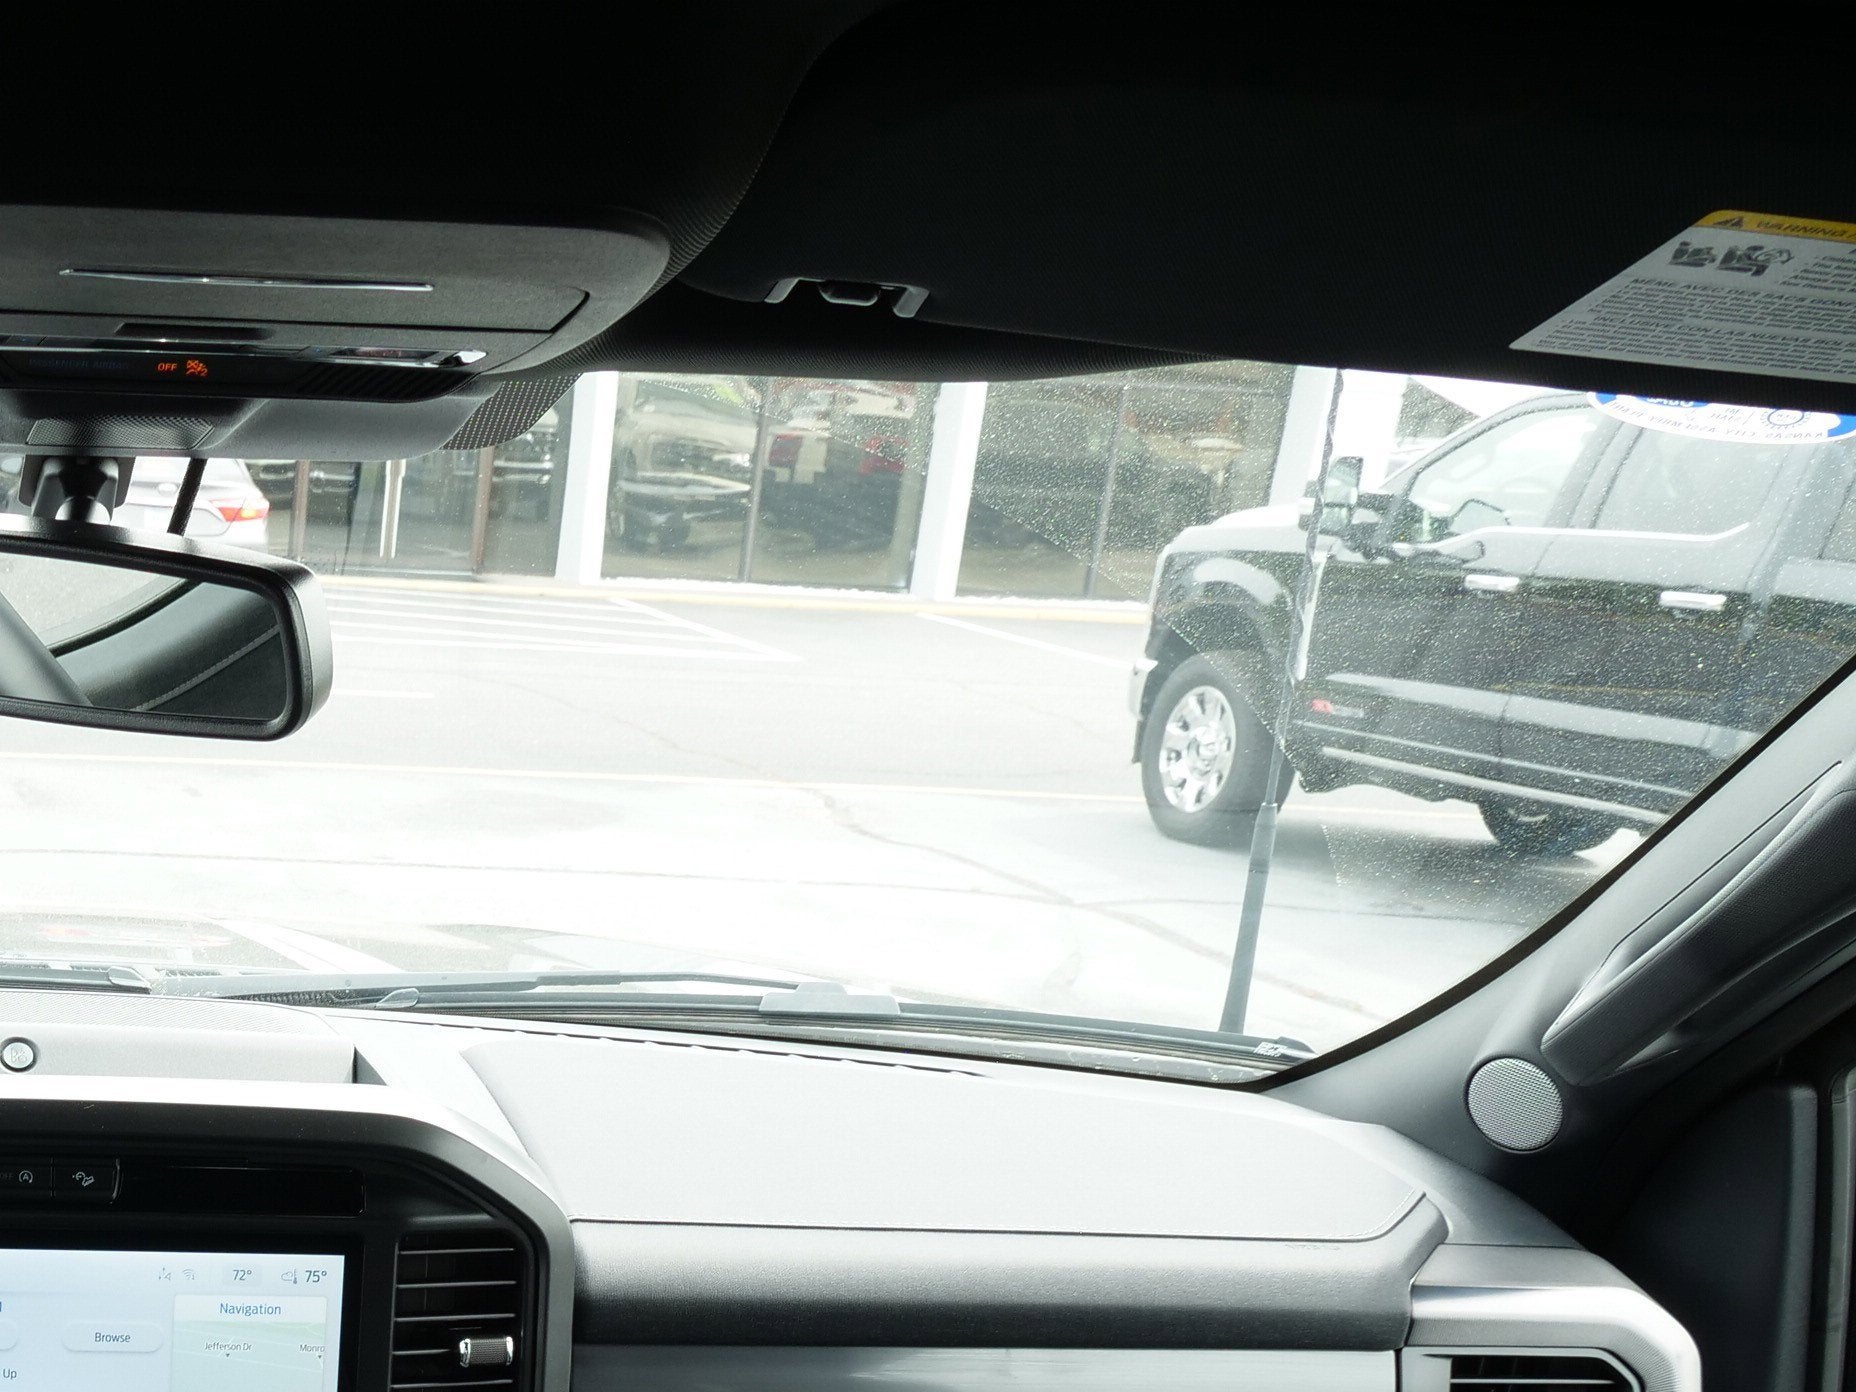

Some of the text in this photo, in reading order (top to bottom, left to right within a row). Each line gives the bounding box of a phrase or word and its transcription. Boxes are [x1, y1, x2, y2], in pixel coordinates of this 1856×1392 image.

[157, 363, 178, 372] OFF
[232, 1270, 252, 1281] 72°
[305, 1270, 327, 1283] 75°
[219, 1303, 282, 1317] Navigation
[95, 1332, 131, 1343] Browse
[205, 1342, 252, 1352] Jefferson Dr
[3, 1369, 17, 1381] Up
